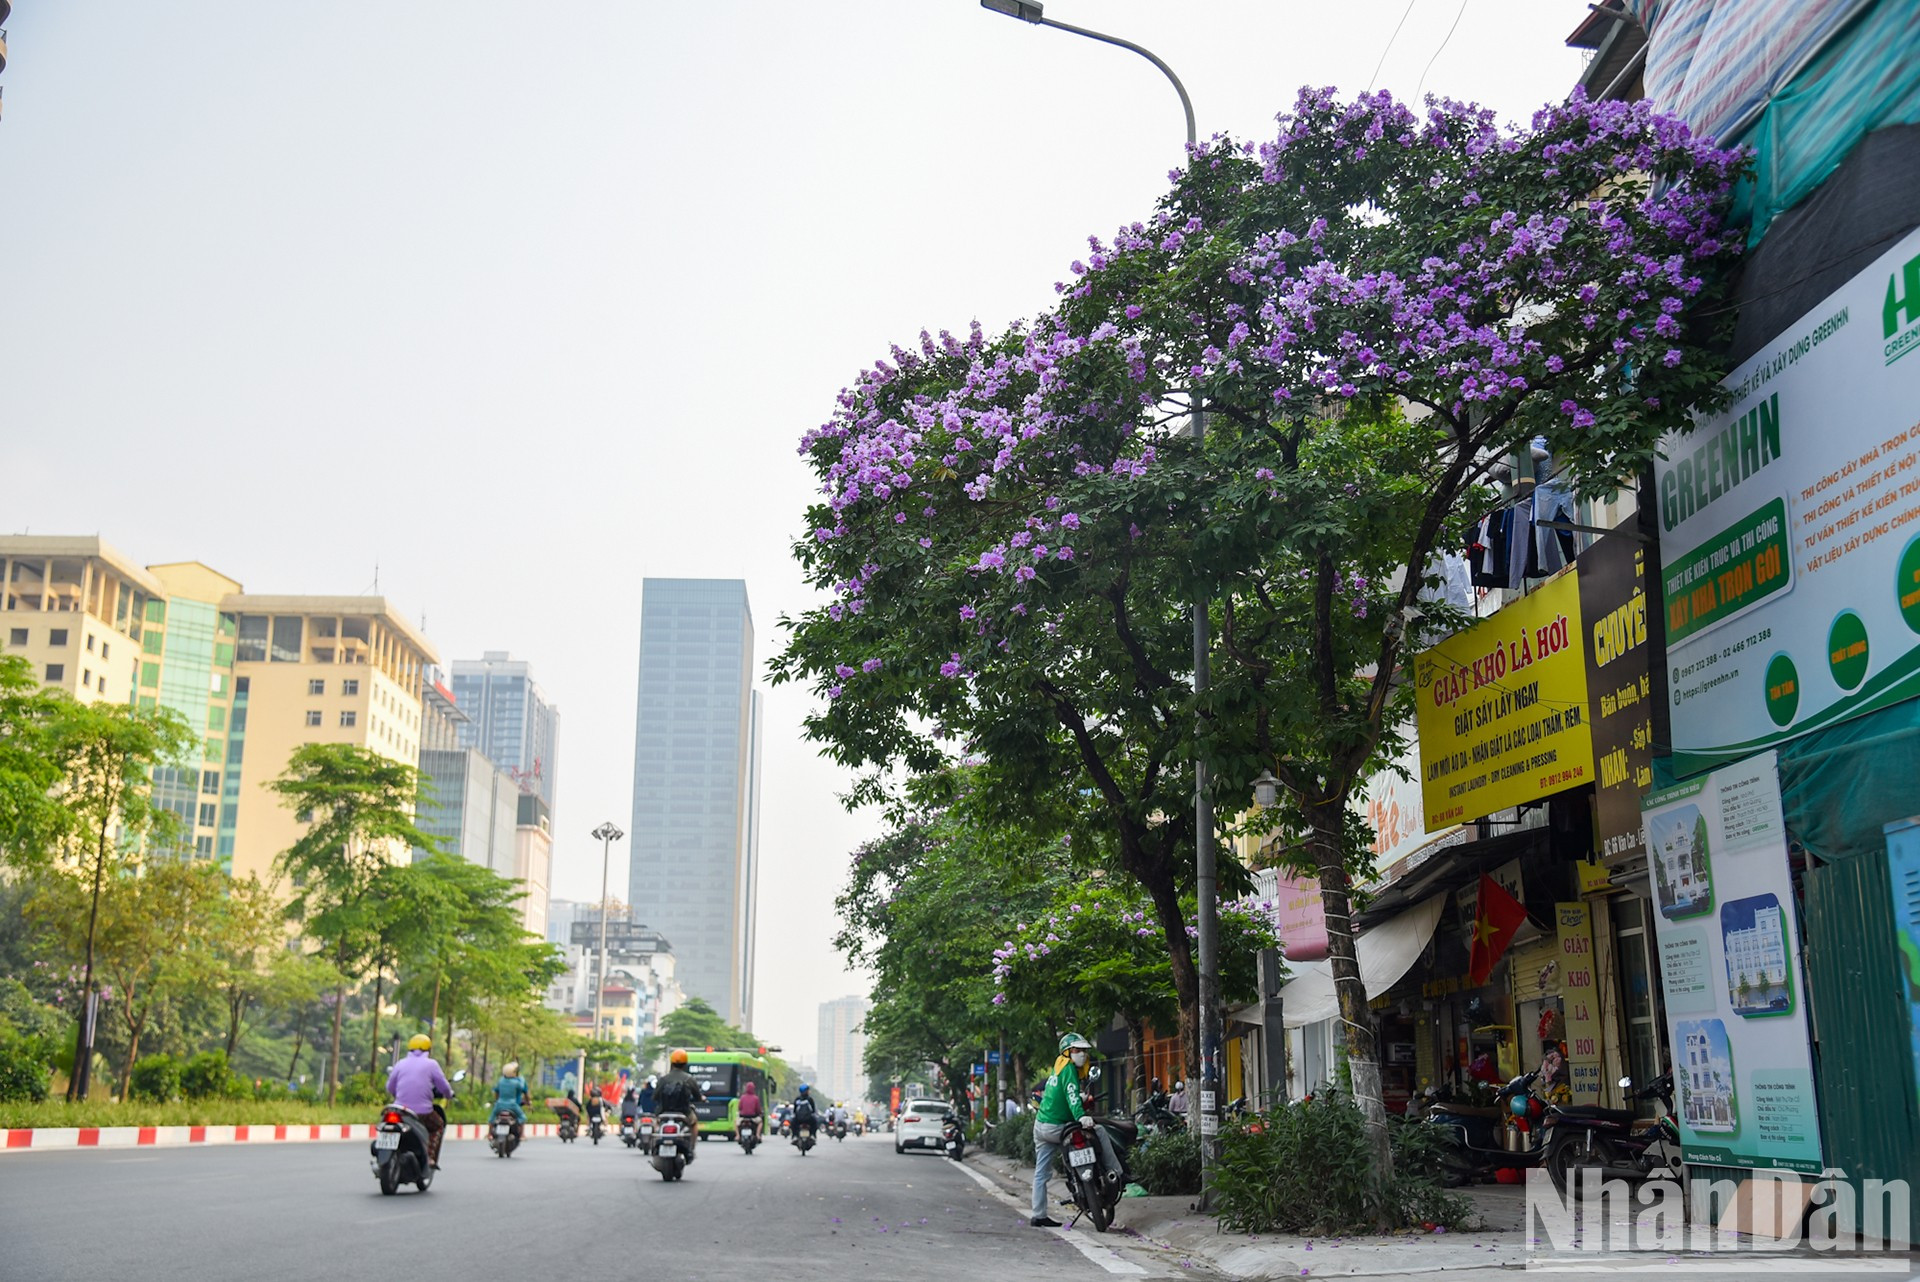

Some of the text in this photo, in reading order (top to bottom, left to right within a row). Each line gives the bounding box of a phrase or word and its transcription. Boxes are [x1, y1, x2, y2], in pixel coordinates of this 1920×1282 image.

[1751, 365, 1760, 391] KẾ
[1760, 364, 1771, 386] VÀ
[1772, 352, 1787, 377] XÂY
[1788, 337, 1810, 365] DỰNG
[1812, 306, 1849, 347] GREENHN
[1884, 325, 1920, 357] GREEN
[1661, 391, 1781, 532] GREENHN
[1801, 485, 1815, 502] THI
[1816, 471, 1839, 493] CÔNG
[1840, 460, 1858, 480] XÂY
[1859, 446, 1880, 468] NHÀ
[1881, 431, 1908, 454] TRỌN
[1803, 452, 1917, 525] THI CÔNG VÀ THIẾT KẾ NỘI
[1741, 529, 1755, 552] THI
[1755, 515, 1778, 544] CÔNG
[1804, 532, 1817, 549] TƯ
[1817, 521, 1835, 543] VẤN
[1835, 508, 1860, 533] THIẾT
[1861, 497, 1874, 519] KẾ
[1875, 487, 1898, 511] KIẾN
[1806, 555, 1823, 573] VẬT
[1824, 544, 1843, 565] LIỆU
[1843, 533, 1861, 554] XÂY
[1863, 522, 1890, 546] DỰNG
[1691, 577, 1717, 620] NHÀ
[1717, 559, 1753, 605] TRỌN
[1755, 542, 1781, 586] GÓI
[1593, 586, 1647, 668] CHUYÊ
[1434, 614, 1569, 708] GIẶT KHÔ LÀ HƠI
[1722, 647, 1731, 659] 02
[1454, 681, 1539, 738] GIẶT SẤY LẤY NGAY
[1600, 693, 1617, 719] Bán
[1427, 760, 1439, 782] LÀM
[1451, 751, 1460, 773] ÁO
[1459, 749, 1468, 770] DA
[1472, 740, 1489, 765] NHẬN
[1504, 728, 1513, 753] LÀ
[1513, 724, 1527, 750] CÁC
[1527, 719, 1541, 745] LOẠI
[1448, 782, 1467, 799] INSTANT
[1468, 776, 1487, 793] LAUNDRY
[1491, 771, 1501, 786] DRY
[1501, 760, 1525, 780] CLEANING
[1525, 757, 1531, 772] &
[1531, 748, 1557, 770] PRESSING
[1600, 745, 1629, 790] NHẬN:
[1617, 832, 1626, 851] Văn
[1626, 831, 1636, 849] Cao
[1563, 933, 1589, 958] GIẶT
[1567, 966, 1591, 988] KHÔ
[1575, 1001, 1589, 1021] LÀ
[1575, 1036, 1595, 1056] HƠI
[1067, 1082, 1080, 1105] Grab
